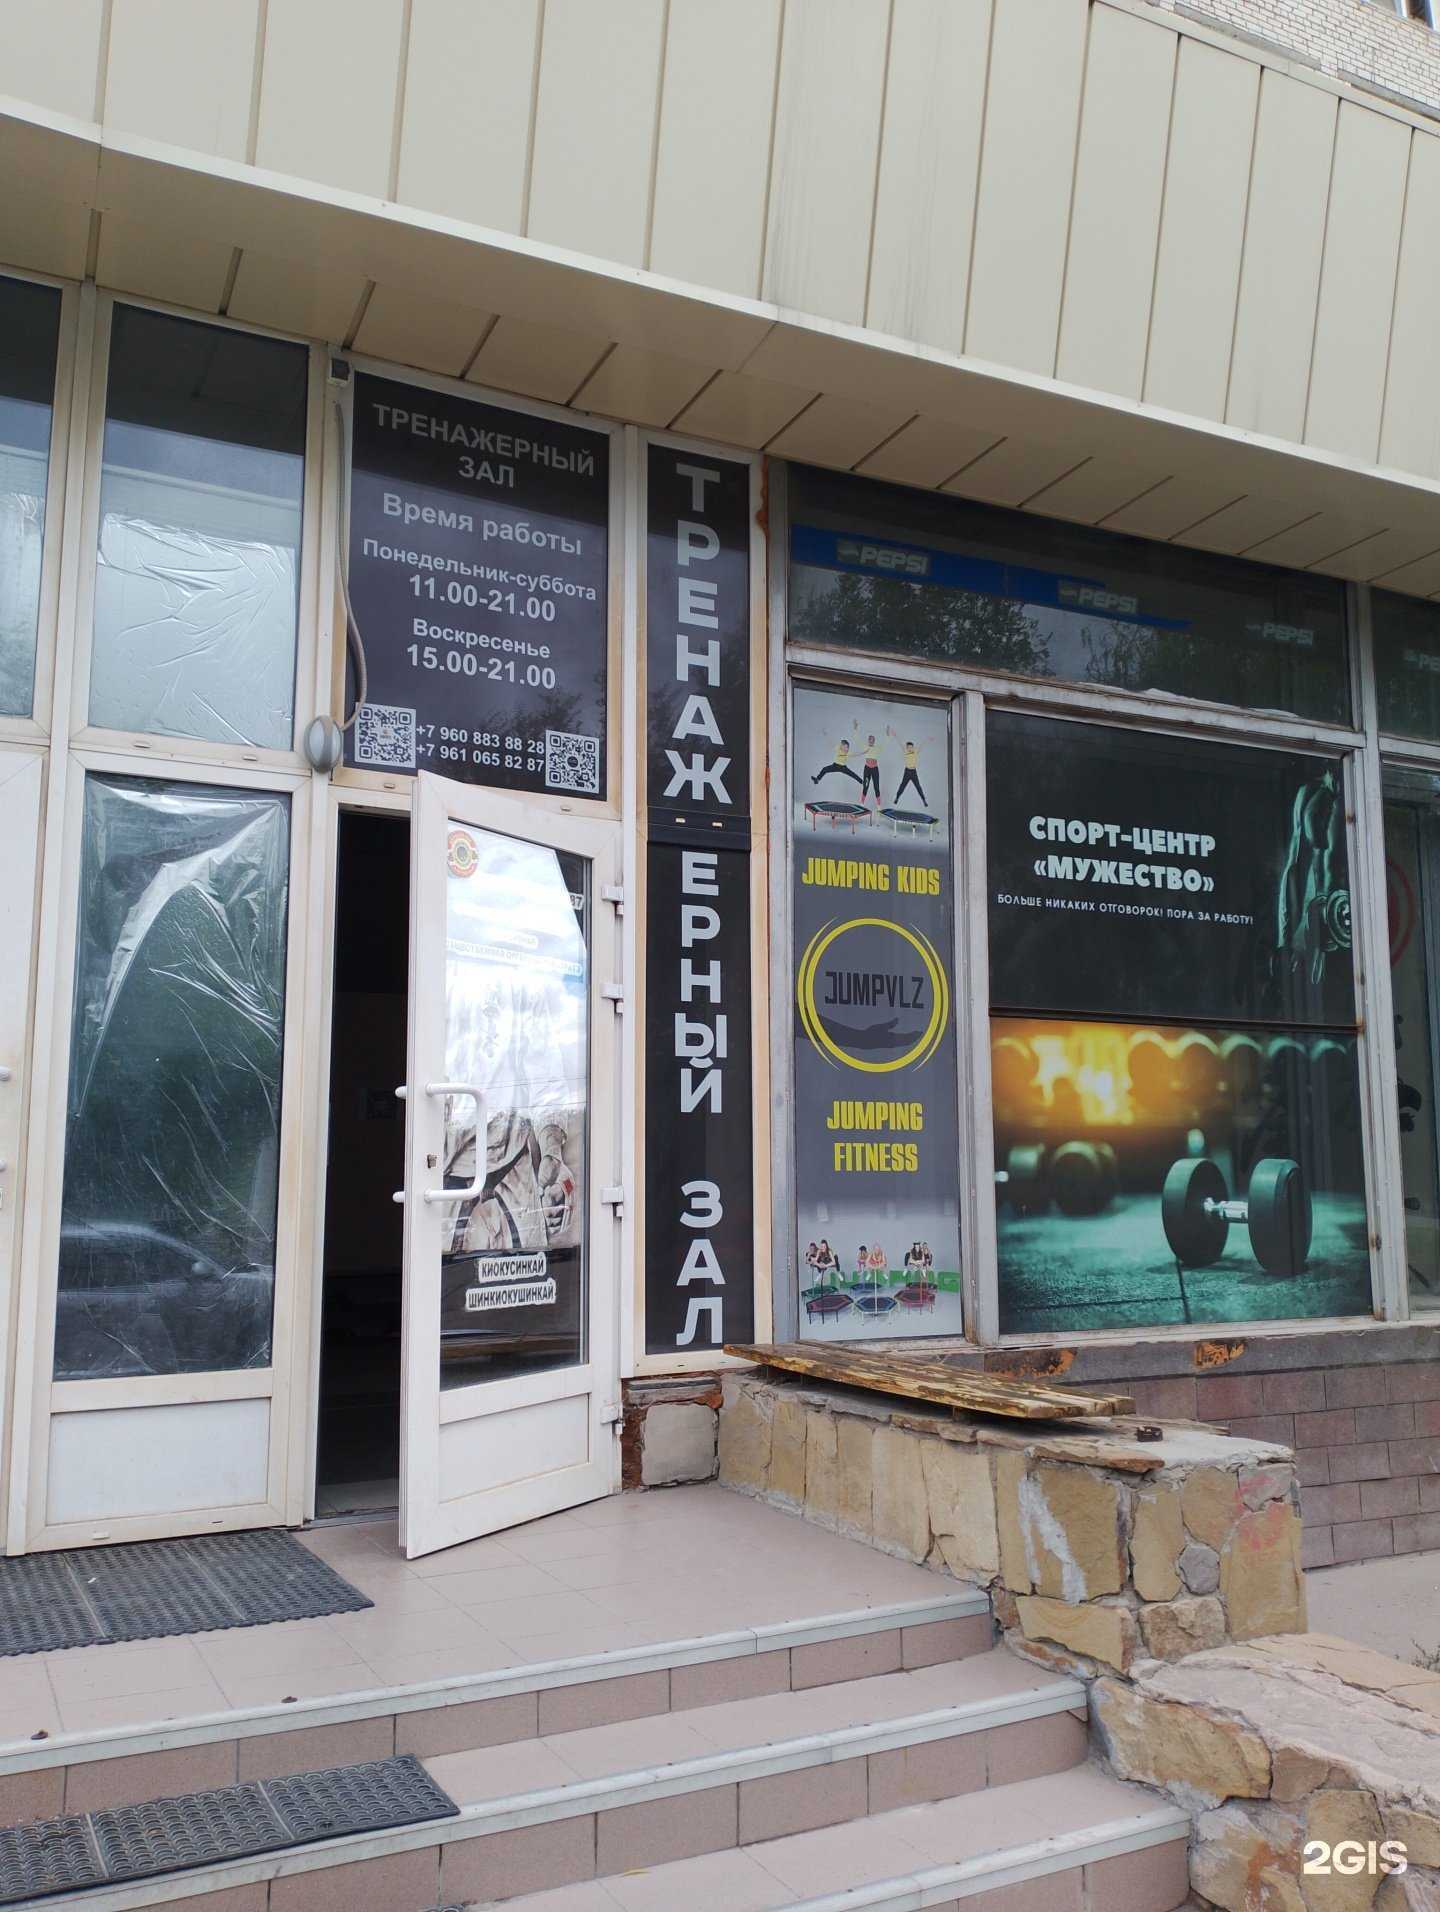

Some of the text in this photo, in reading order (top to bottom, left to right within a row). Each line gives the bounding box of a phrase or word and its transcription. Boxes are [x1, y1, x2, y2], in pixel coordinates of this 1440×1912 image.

[372, 403, 595, 477] ТРЕНАЖЕРНЫЙ
[458, 456, 515, 489] ЗАЛ
[383, 492, 582, 555] Время работы
[362, 537, 598, 601] Понедельник-суббота
[860, 545, 928, 575] PEPSI
[408, 574, 556, 622] 11.00-21.00
[1078, 587, 1138, 614] PEPSI
[412, 618, 551, 660] Воскресенье
[407, 643, 556, 690] 15.00-21.00
[416, 724, 545, 755] +7 960 883 88 28
[416, 743, 544, 773] +7 961 065 82 87
[1028, 815, 1216, 857] СПОРТ-ЦЕНТР
[802, 857, 940, 896] JUMPING KIDS
[1033, 854, 1215, 893] «МУЖЕСТВО»
[997, 894, 1042, 907] БОЛЬШЕ
[1045, 898, 1095, 912] НИКАКИХ
[1099, 902, 1163, 917] ОТГОВОРОК!
[1166, 908, 1194, 920] ПОРА
[1198, 911, 1211, 921] ЗА
[827, 1099, 923, 1131] JUMPING
[833, 1141, 919, 1174] FITNESS
[481, 1255, 545, 1278] КИОКУСИНКАЙ
[675, 1180, 726, 1347] ЗАЛ
[468, 1281, 554, 1309] ШИНКИОКУШИНКАЙ
